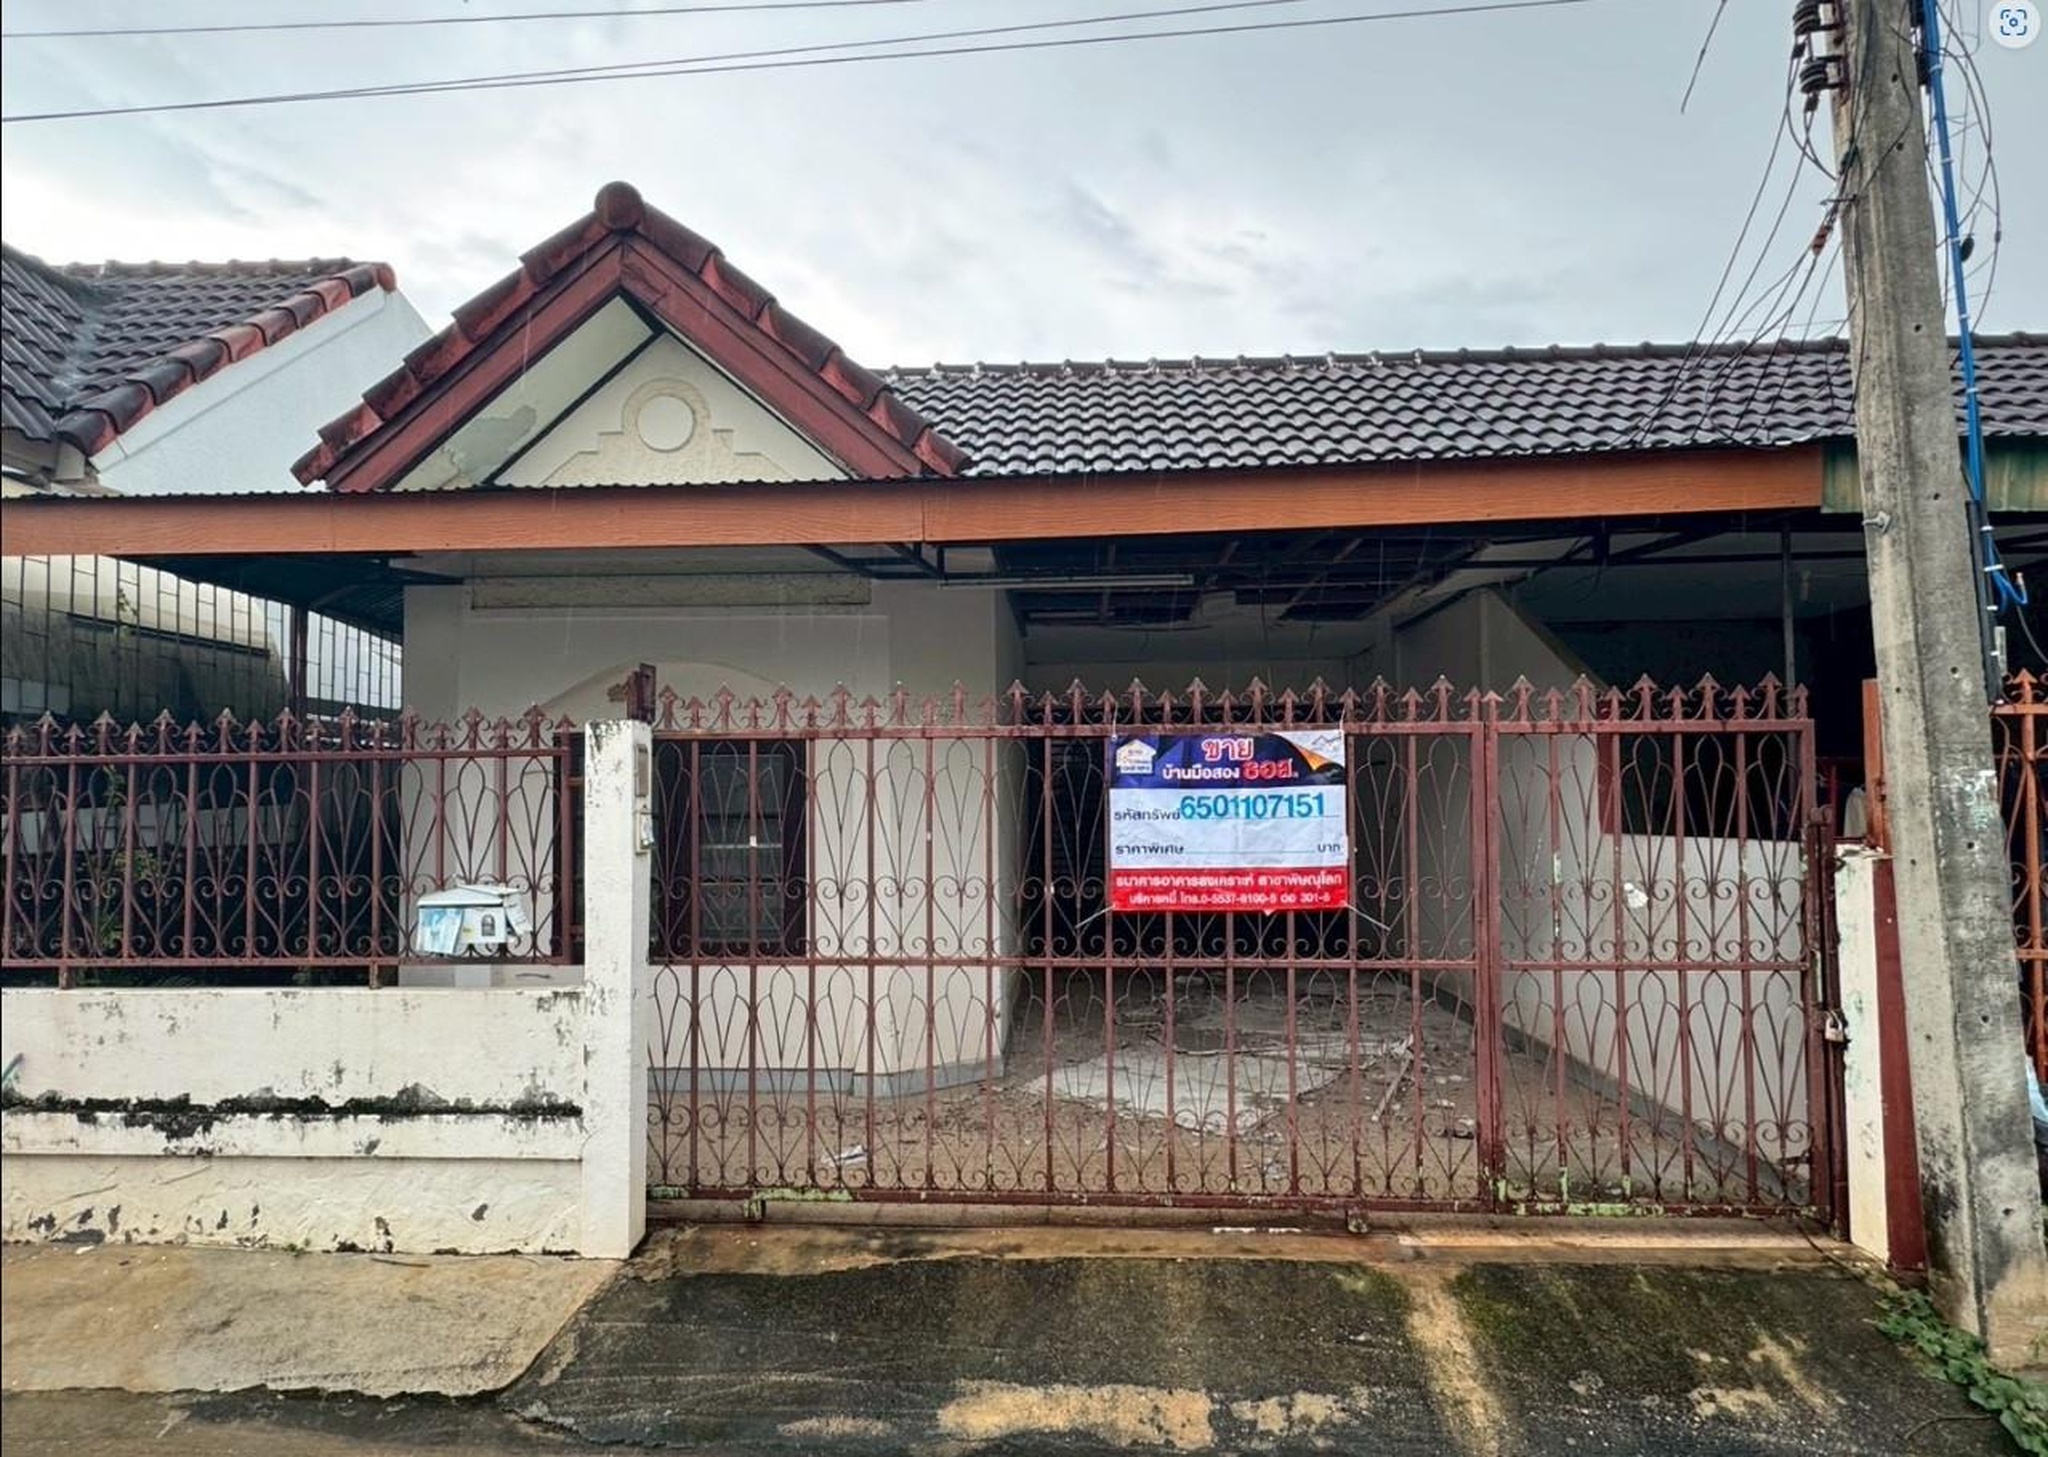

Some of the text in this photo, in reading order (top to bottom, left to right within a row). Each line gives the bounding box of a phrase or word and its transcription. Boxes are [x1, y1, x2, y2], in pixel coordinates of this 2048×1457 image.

[1201, 738, 1254, 762] ขาย
[1162, 758, 1299, 779] บ้านมือสอง ธอส.
[1180, 793, 1324, 819] 6501107151
[1115, 842, 1341, 855] ราคาพิเศษ บาท
